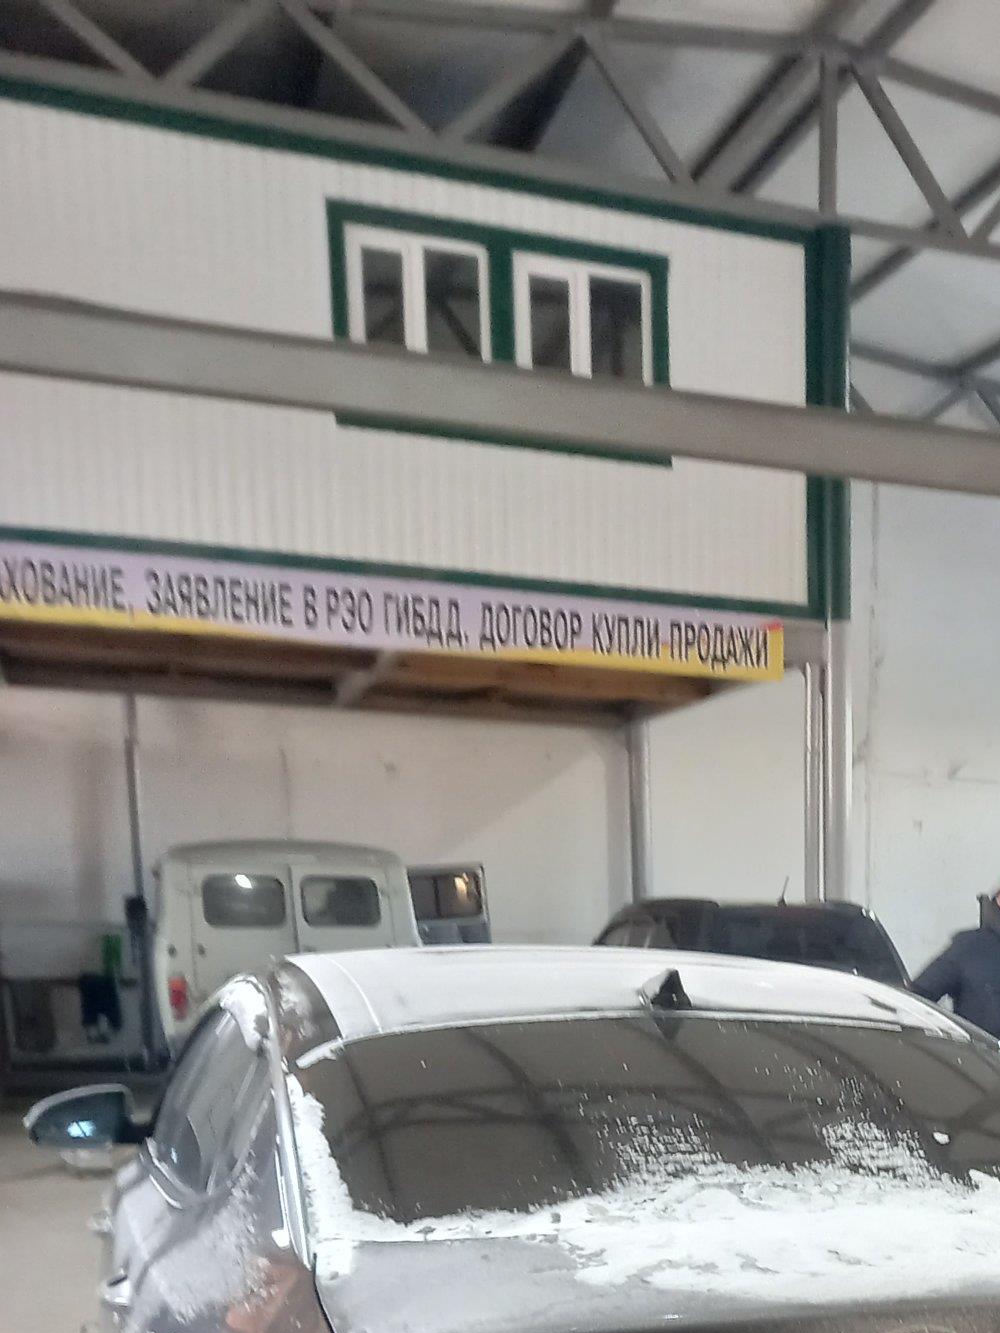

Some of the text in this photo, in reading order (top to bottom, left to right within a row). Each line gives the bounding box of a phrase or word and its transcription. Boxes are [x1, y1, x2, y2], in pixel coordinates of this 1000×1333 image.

[145, 567, 293, 627] ЗАЯВЛЕНИЕ
[303, 584, 318, 629] В
[480, 601, 582, 653] ДОГОВОР
[592, 612, 660, 658] КУПЛИ
[669, 621, 770, 672] ПРОДАЖИ
